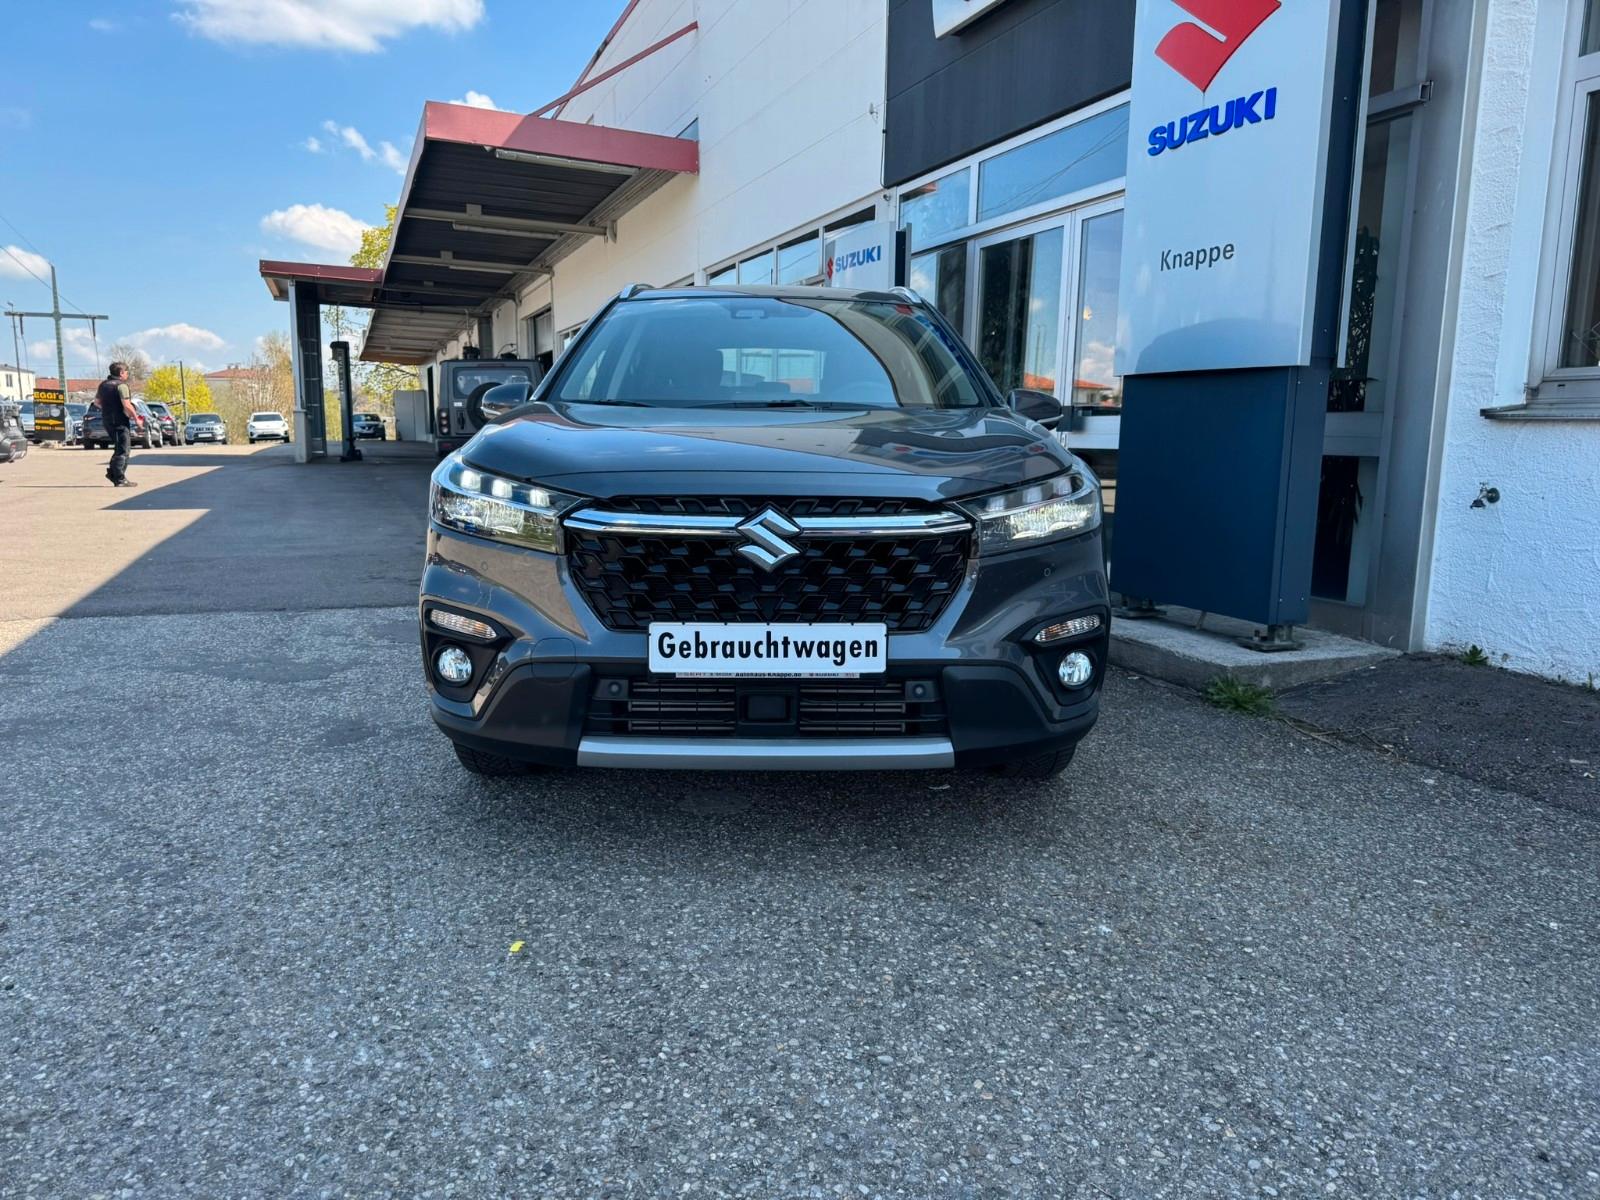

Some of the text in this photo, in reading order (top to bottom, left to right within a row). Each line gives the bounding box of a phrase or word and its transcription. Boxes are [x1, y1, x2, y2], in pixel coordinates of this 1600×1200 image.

[1147, 87, 1277, 156] SUZUKI
[835, 245, 881, 273] SUZUKI
[1160, 242, 1235, 272] Knappe
[657, 631, 878, 667] Gebrauchtwagen
